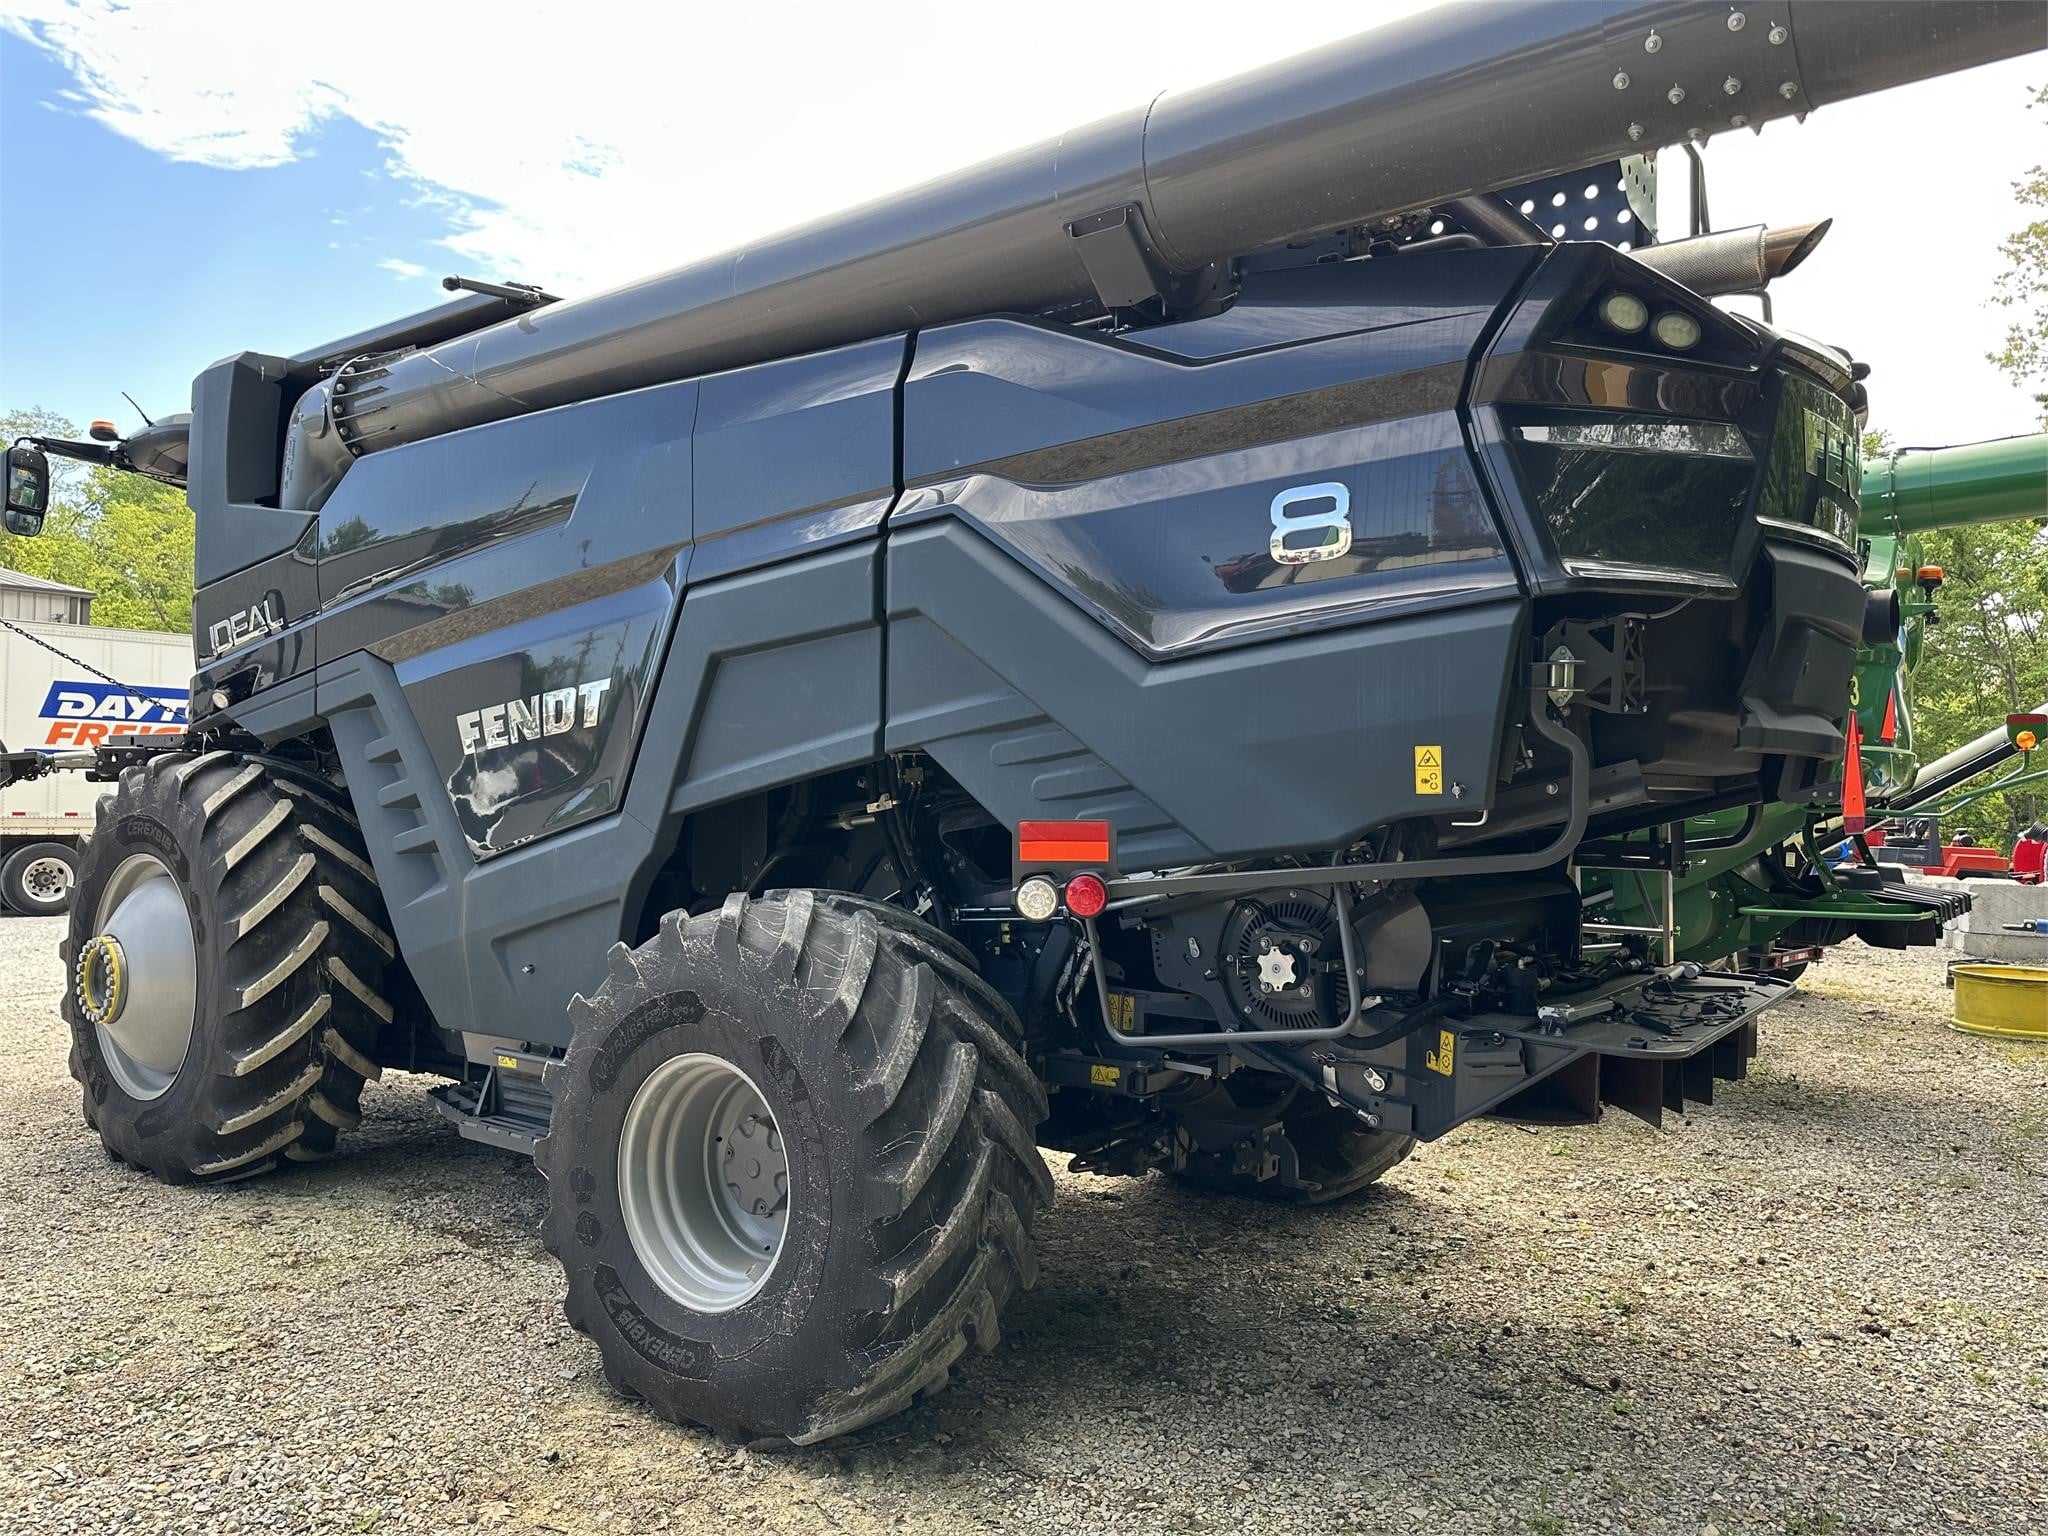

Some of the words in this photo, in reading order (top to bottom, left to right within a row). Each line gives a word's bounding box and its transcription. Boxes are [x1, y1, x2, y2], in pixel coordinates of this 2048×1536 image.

[1270, 481, 1352, 565] 8
[209, 600, 283, 656] IDEAL
[57, 692, 189, 722] DAYT
[456, 678, 611, 756] FENDT
[616, 1308, 696, 1369] CEREXBIB
